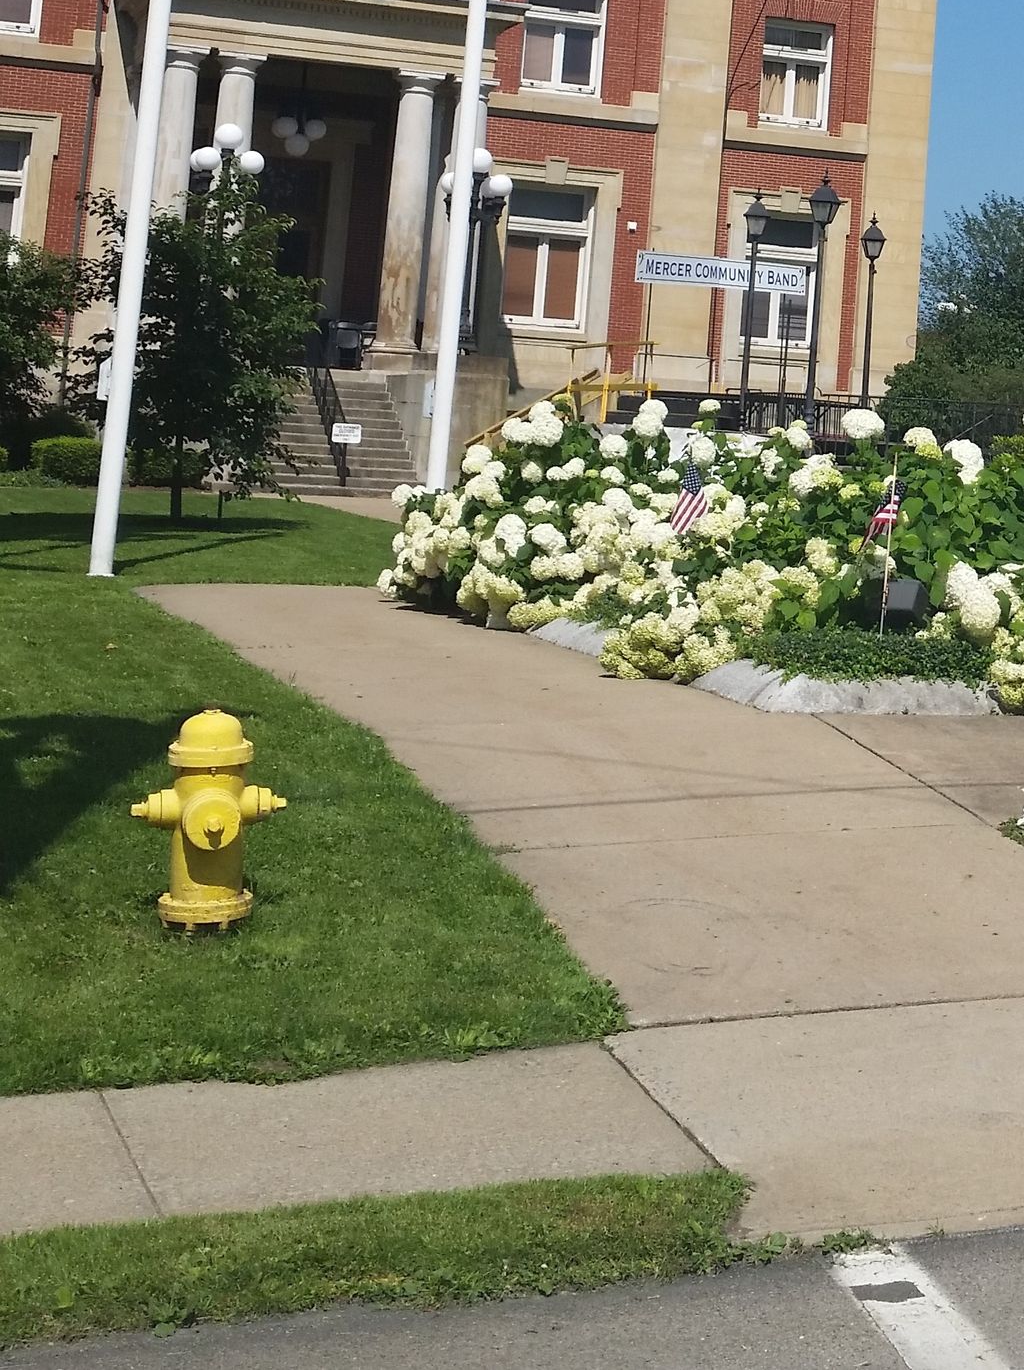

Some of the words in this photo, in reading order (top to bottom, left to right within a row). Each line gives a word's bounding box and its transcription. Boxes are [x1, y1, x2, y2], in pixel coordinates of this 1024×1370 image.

[645, 259, 692, 277] MERCER
[695, 263, 764, 284] COMMUNIY
[767, 271, 798, 287] BAND
